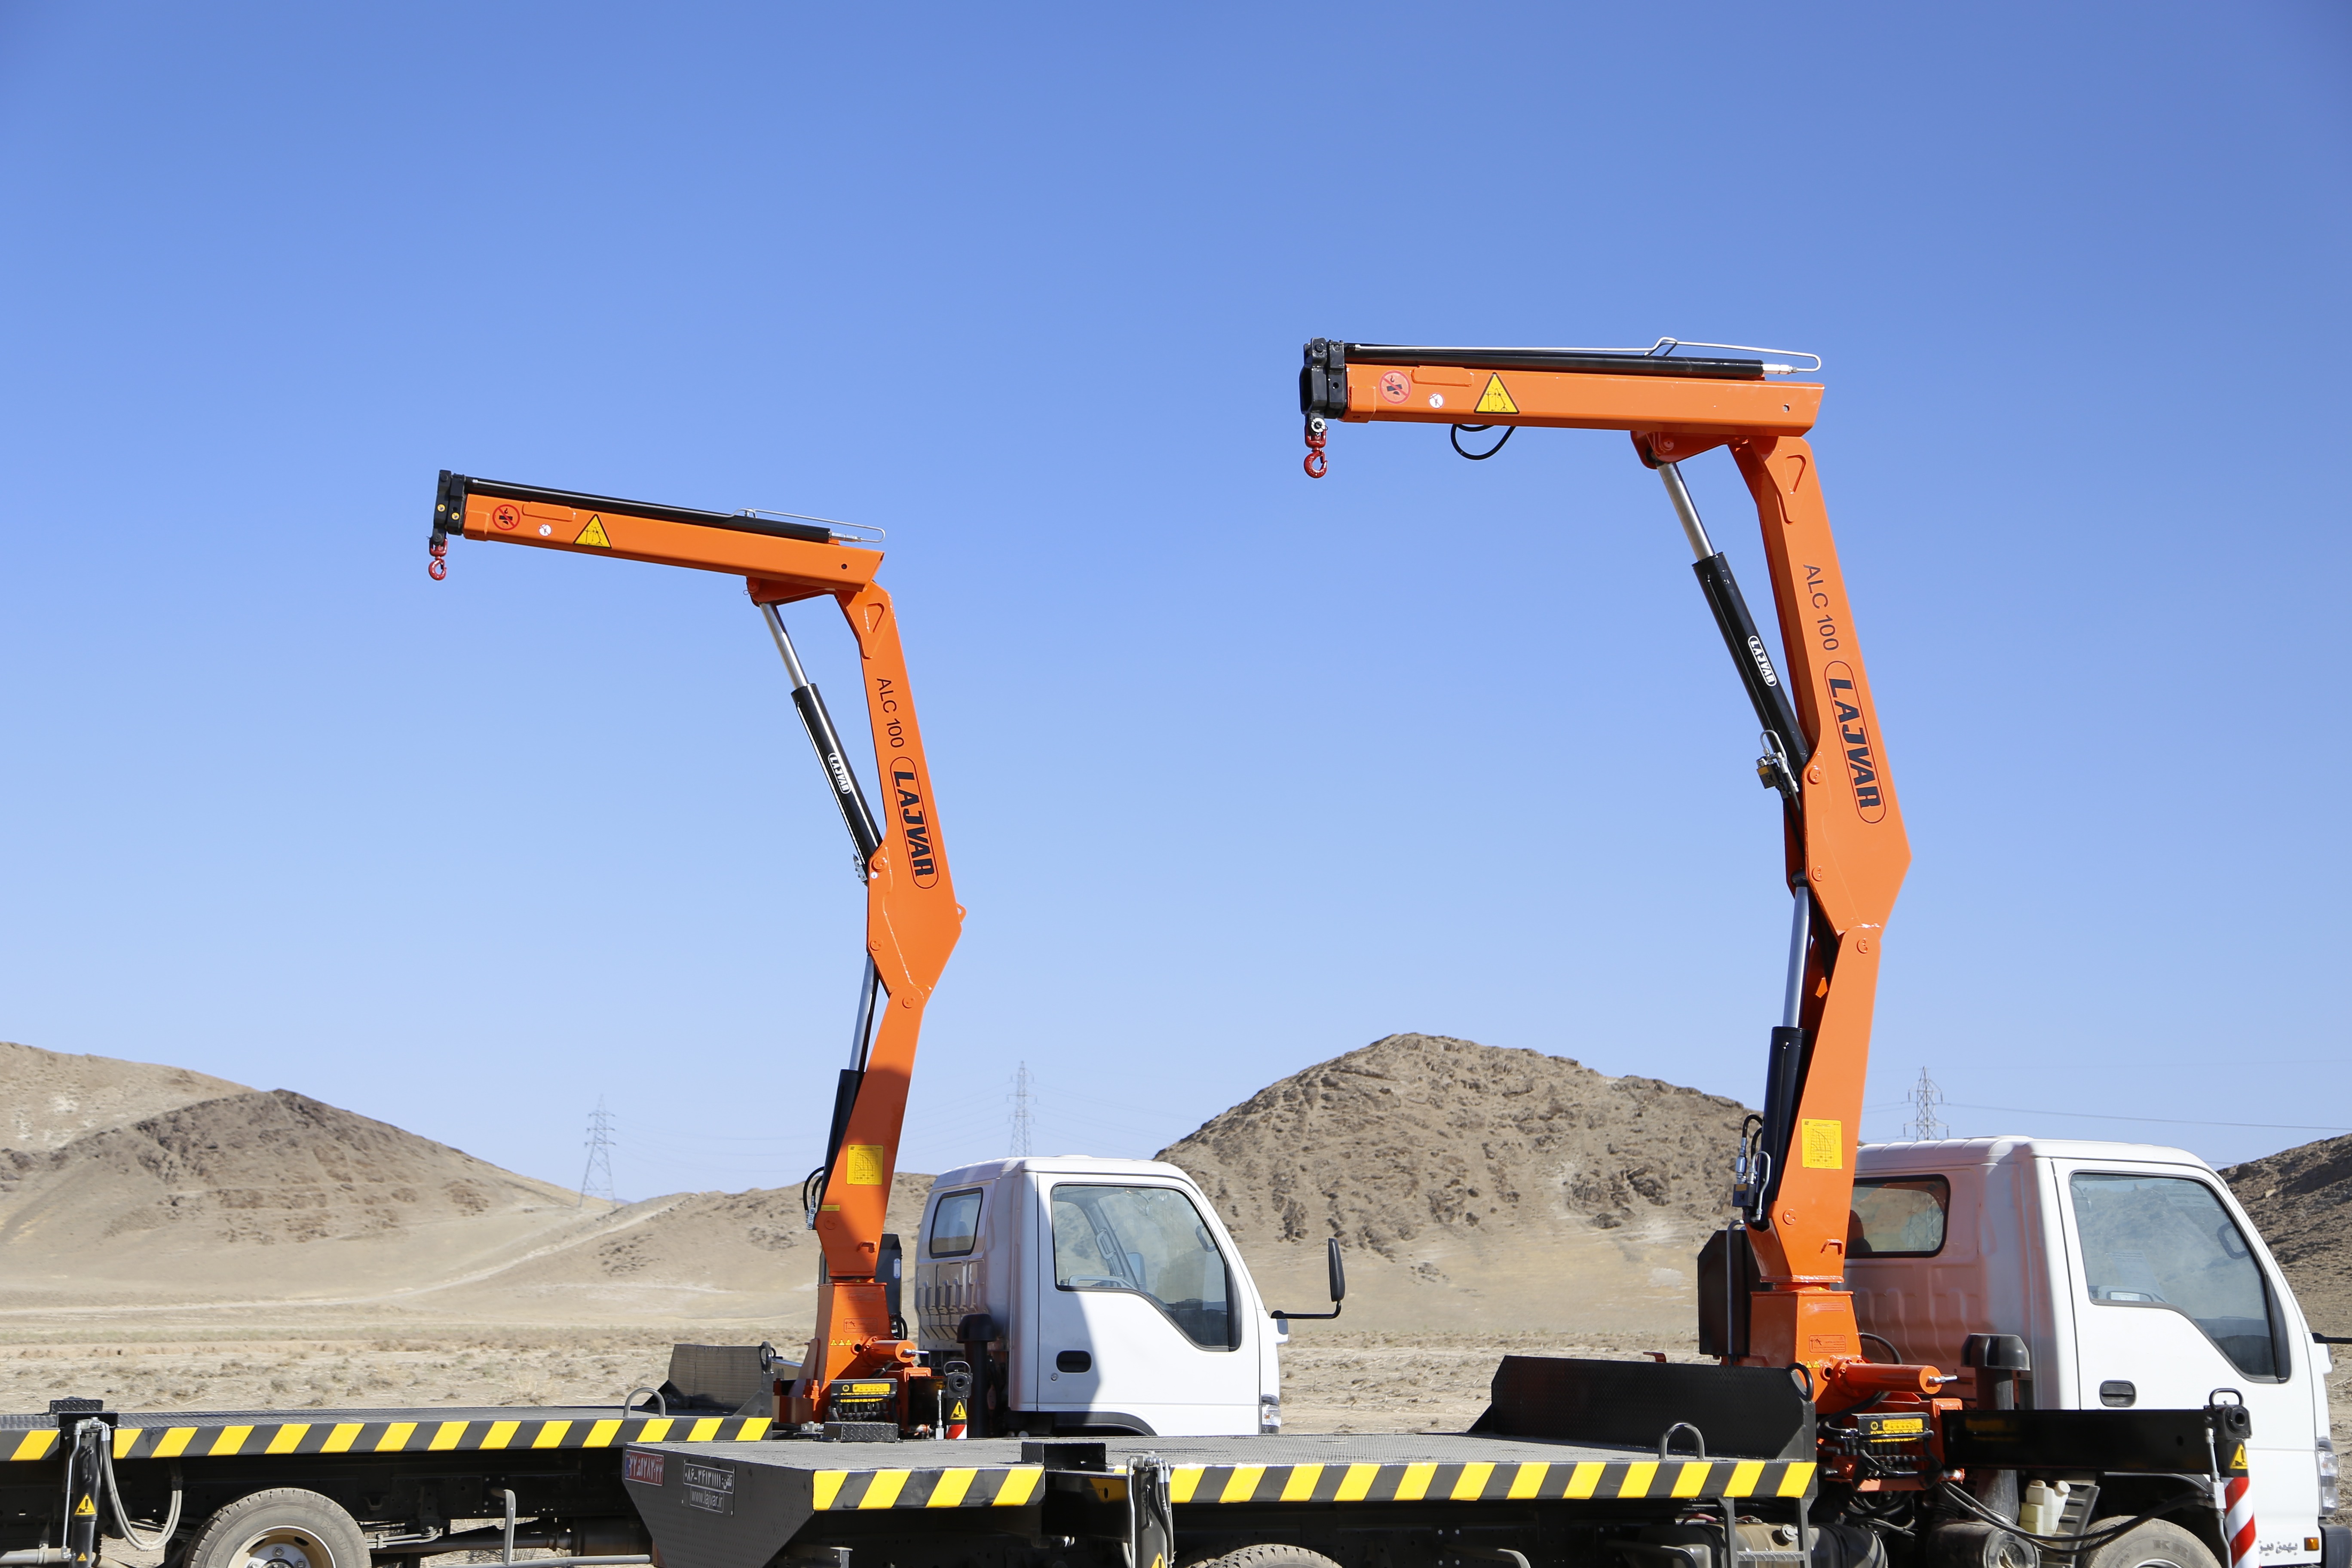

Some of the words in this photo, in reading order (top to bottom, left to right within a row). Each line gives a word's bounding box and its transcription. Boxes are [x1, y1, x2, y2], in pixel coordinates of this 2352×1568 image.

[1803, 564, 1828, 609] ALC
[1817, 614, 1839, 651] 100
[1749, 640, 1776, 683] LAJVAR
[876, 678, 897, 713] ALC
[886, 718, 904, 747] 100
[1828, 678, 1881, 809] LAJVAR
[830, 756, 850, 791] LAJVAR
[894, 771, 935, 877] LAJVAR
[691, 1490, 723, 1508] www.lajvar.ir
